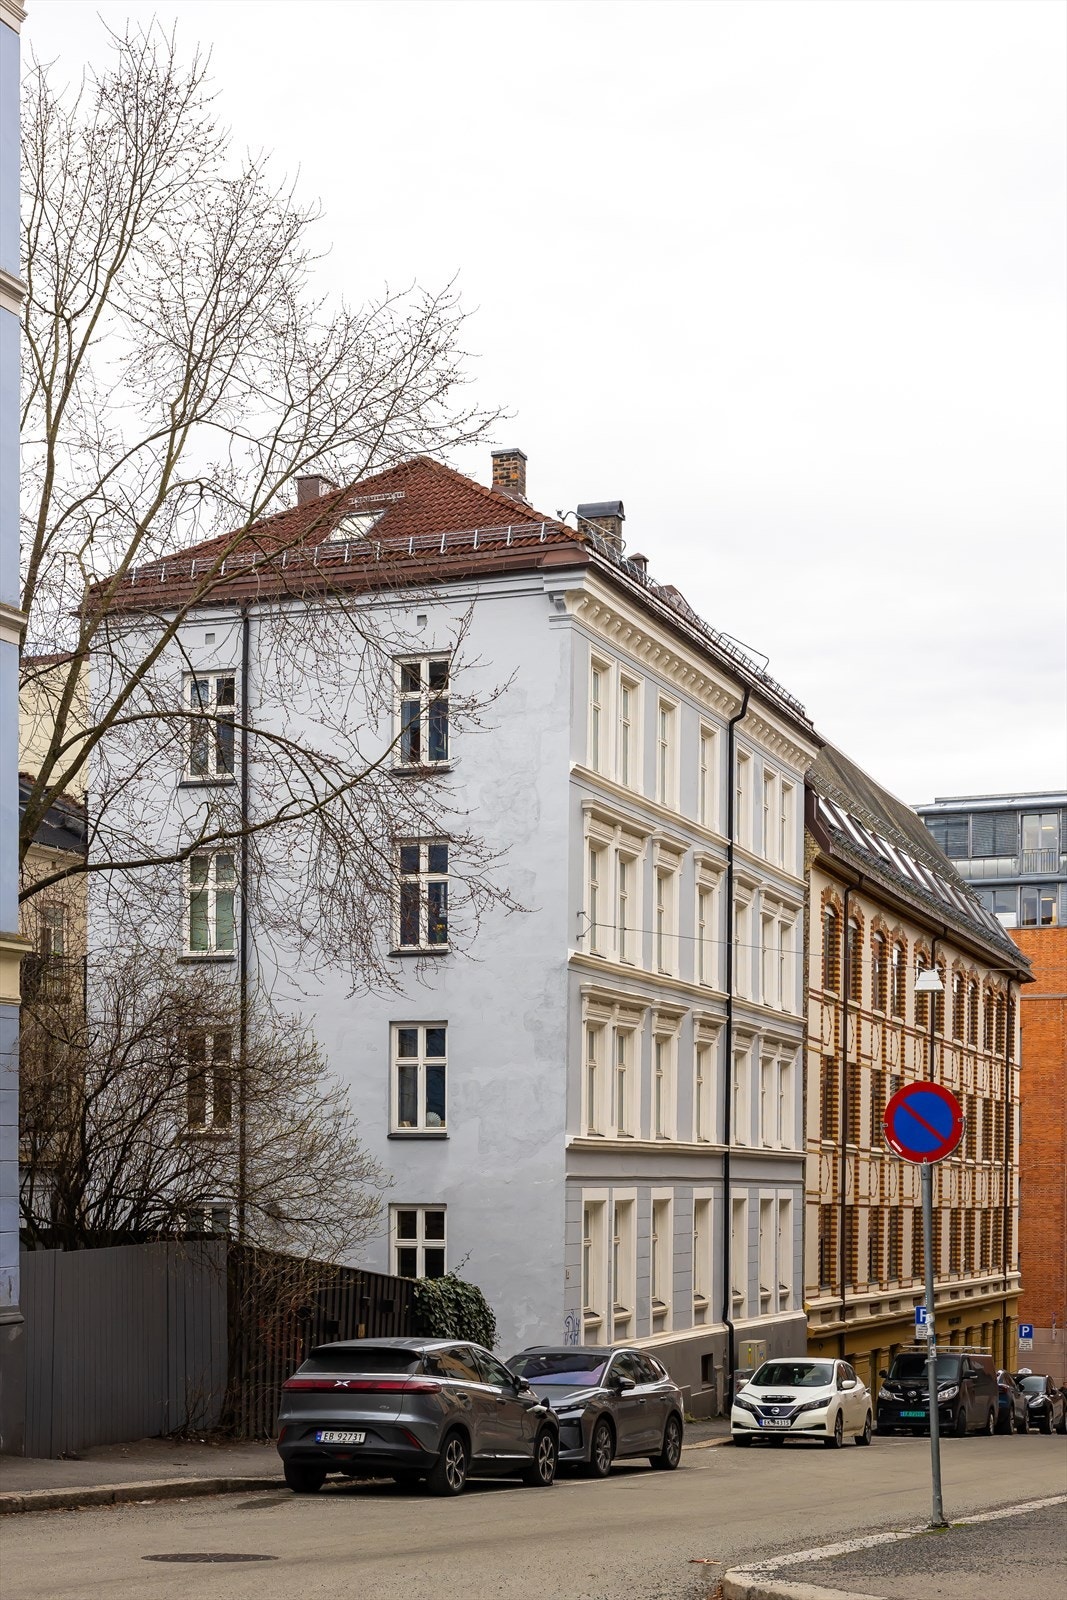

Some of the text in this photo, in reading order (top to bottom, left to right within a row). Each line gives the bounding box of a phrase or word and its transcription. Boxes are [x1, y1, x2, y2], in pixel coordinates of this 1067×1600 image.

[1022, 1326, 1030, 1337] P
[324, 1432, 362, 1441] EB 92731
